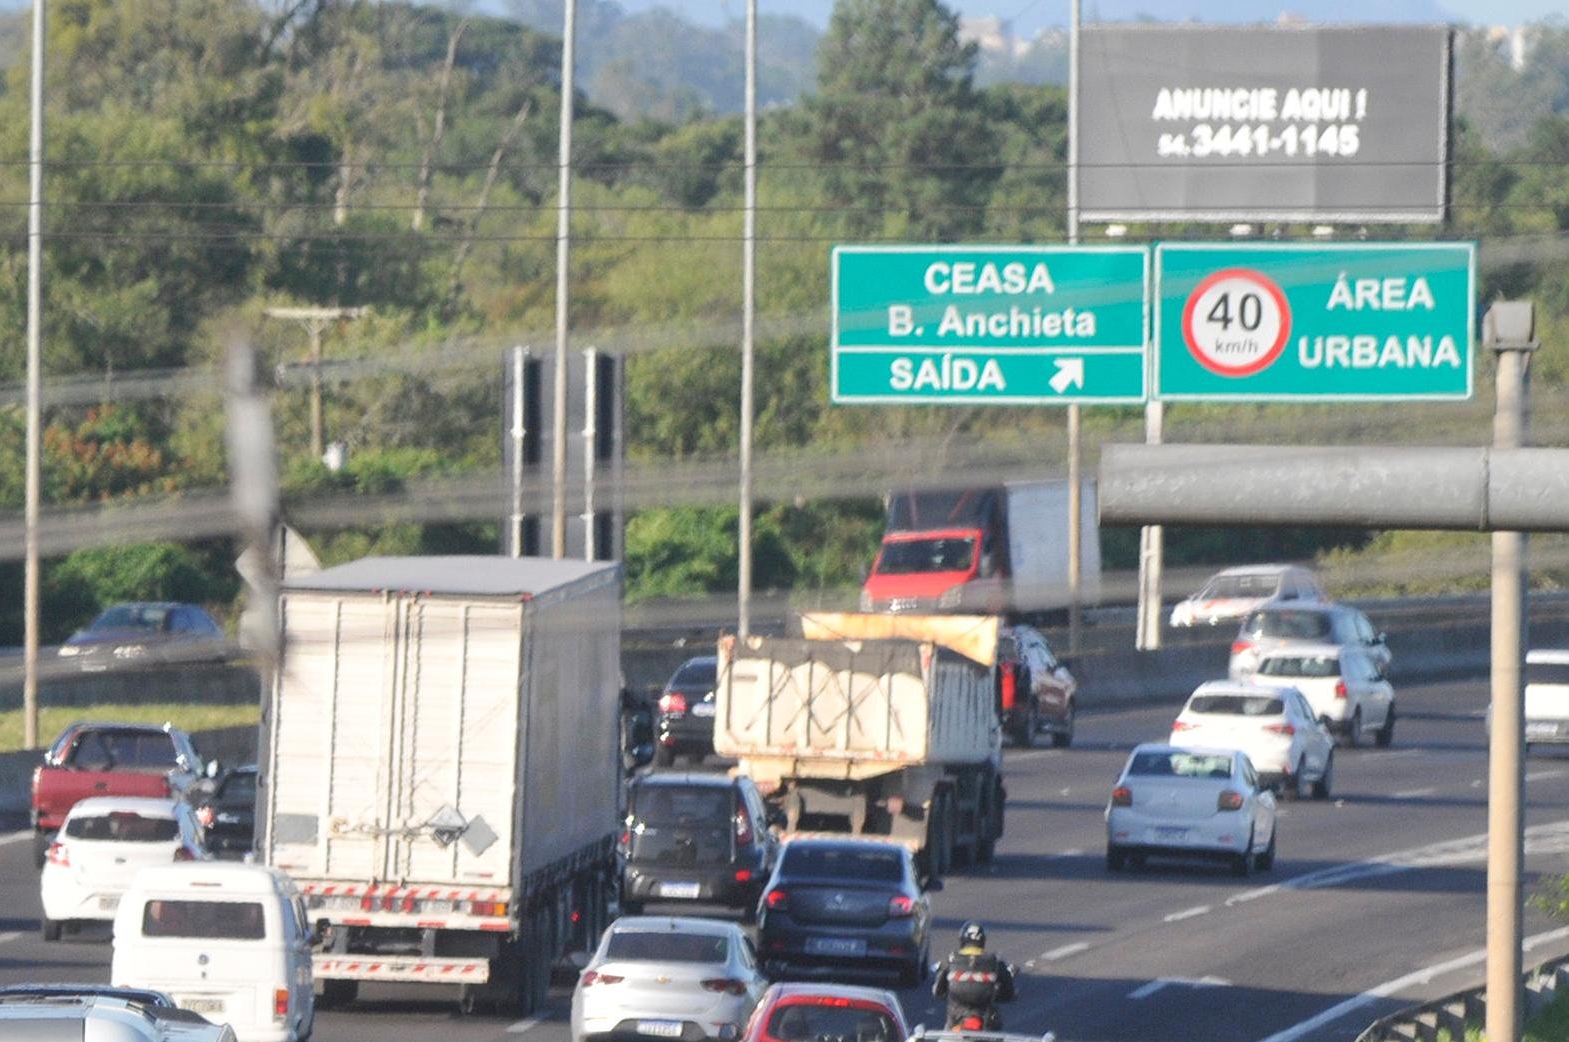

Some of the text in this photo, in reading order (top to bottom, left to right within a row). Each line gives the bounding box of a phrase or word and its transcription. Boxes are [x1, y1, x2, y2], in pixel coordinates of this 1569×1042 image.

[1152, 87, 1279, 120] ANUNCIE
[924, 262, 1056, 294] CEASA
[1327, 271, 1436, 311] ÁREA
[888, 304, 1096, 338] B. Anchieta
[1207, 292, 1263, 332] 40
[1215, 338, 1258, 354] km/h
[1298, 335, 1462, 369] URBANA
[889, 352, 1006, 391] SAÍDA
